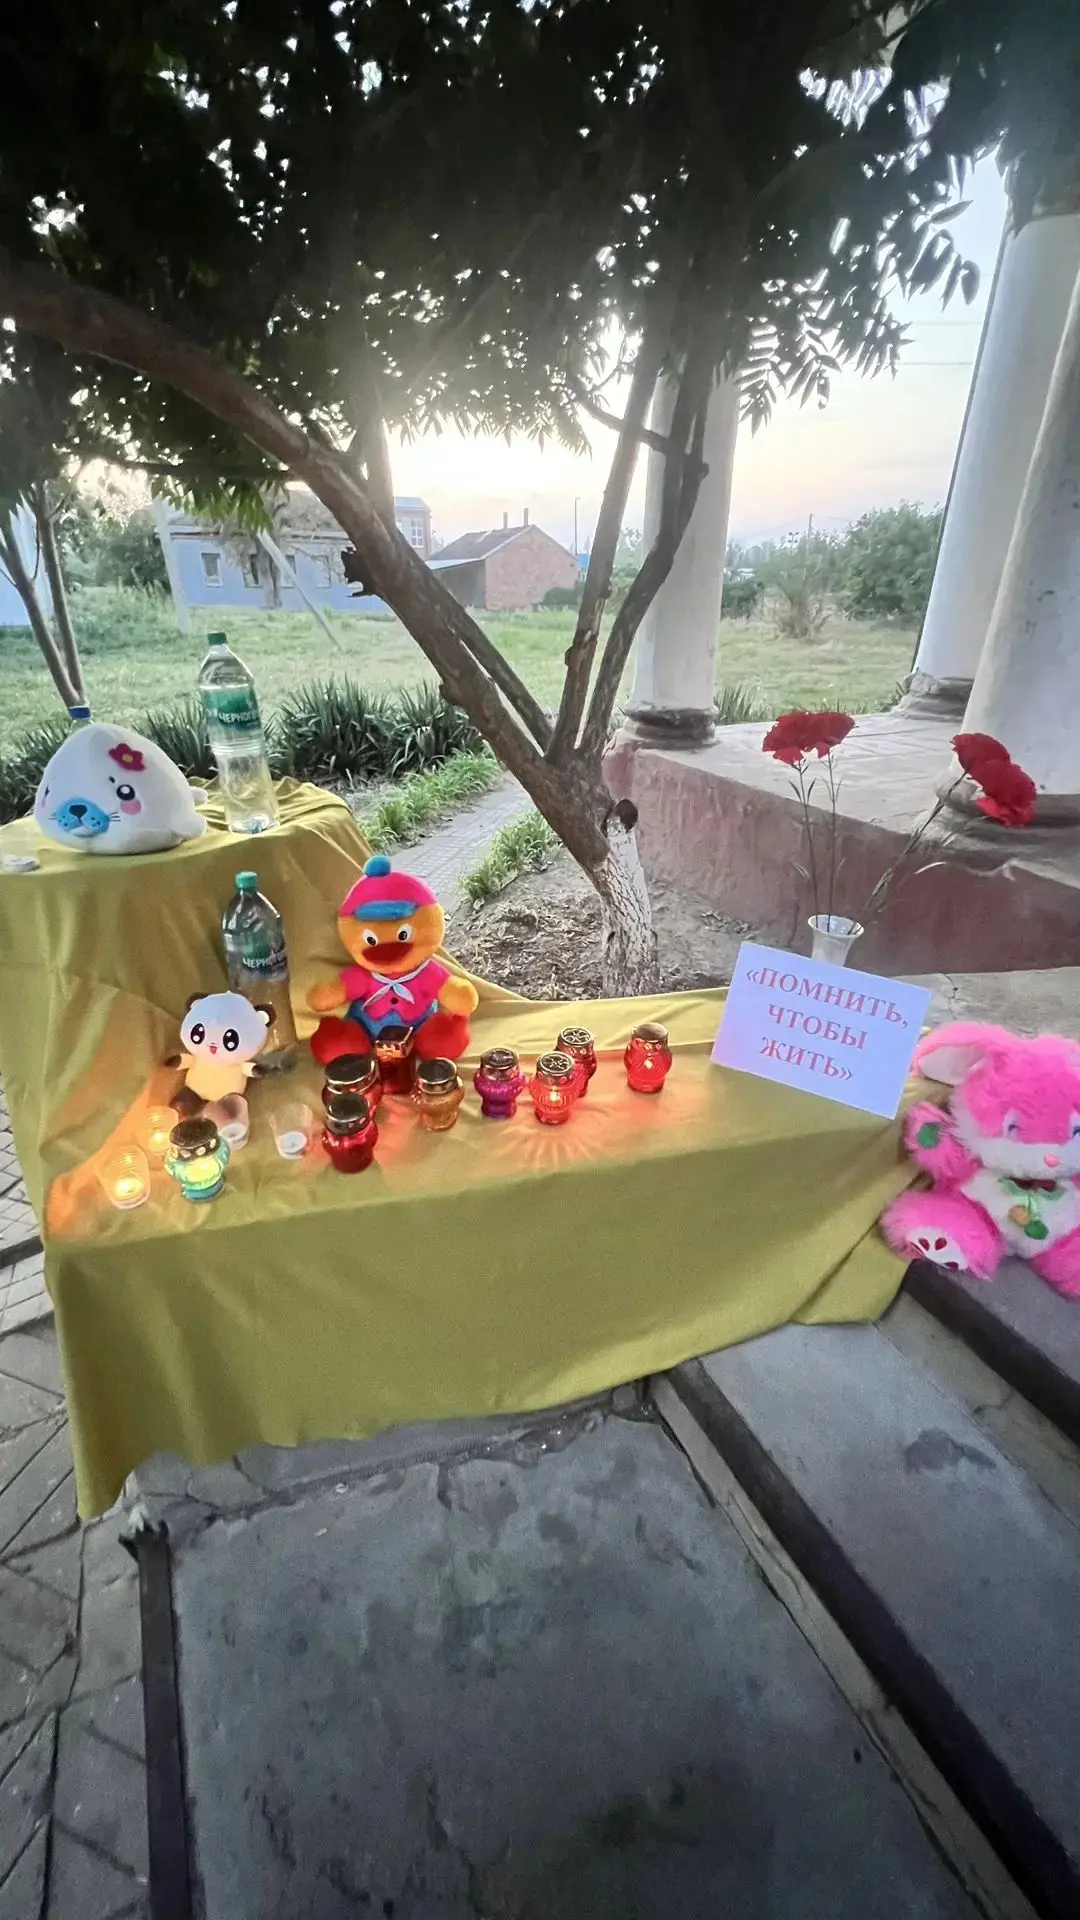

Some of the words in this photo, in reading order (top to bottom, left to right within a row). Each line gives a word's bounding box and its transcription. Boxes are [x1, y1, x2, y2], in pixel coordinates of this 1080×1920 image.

[746, 967, 908, 1029] «ПОМНИТЬ,
[768, 1003, 868, 1050] ЧТОБЫ
[760, 1036, 853, 1081] ЖИТЬ»
